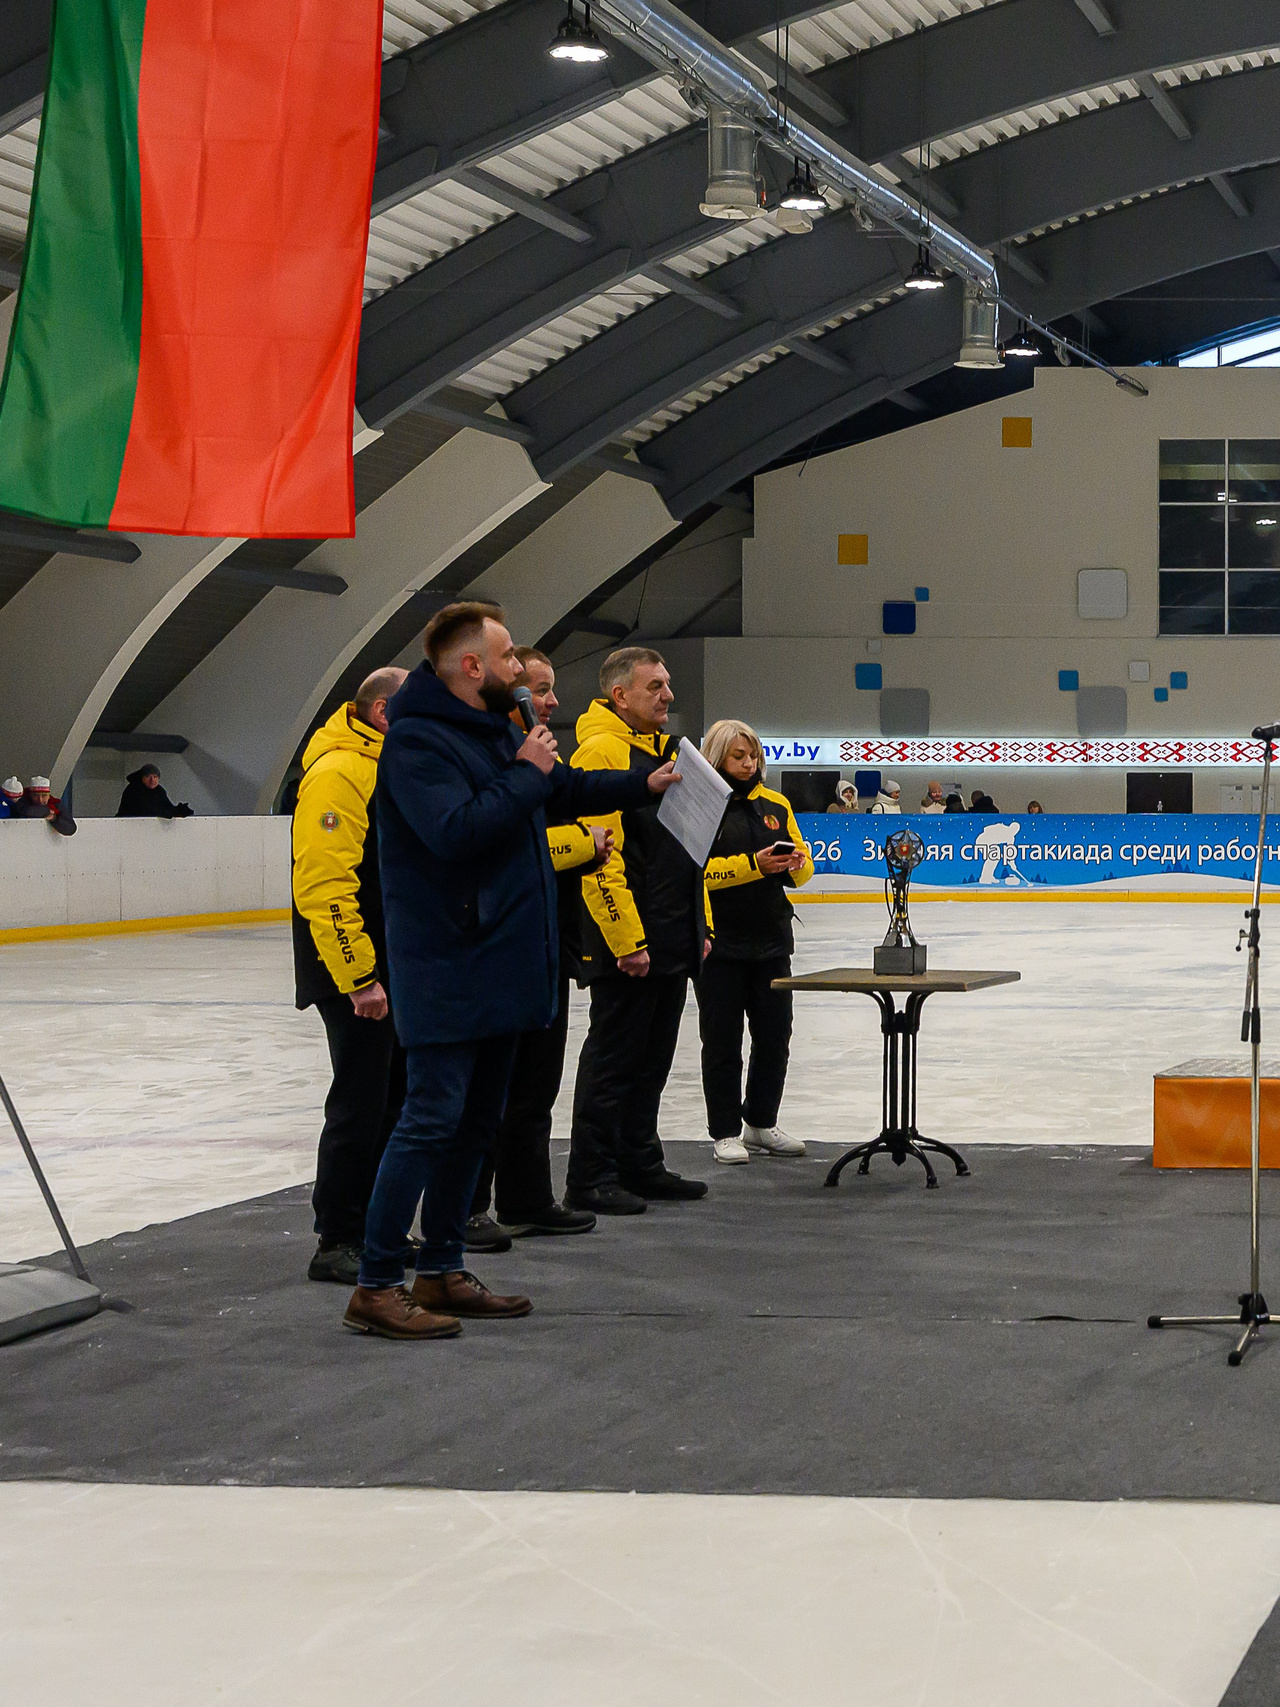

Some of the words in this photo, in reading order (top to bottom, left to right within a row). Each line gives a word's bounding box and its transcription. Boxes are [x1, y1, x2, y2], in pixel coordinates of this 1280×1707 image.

[761, 742, 820, 760] hy.by
[550, 845, 572, 855] RUS
[962, 844, 1113, 866] спартакиада
[1120, 844, 1190, 865] среди
[704, 870, 736, 880] ARUS
[596, 872, 620, 922] ELARUS
[330, 904, 355, 964] BELARUS
